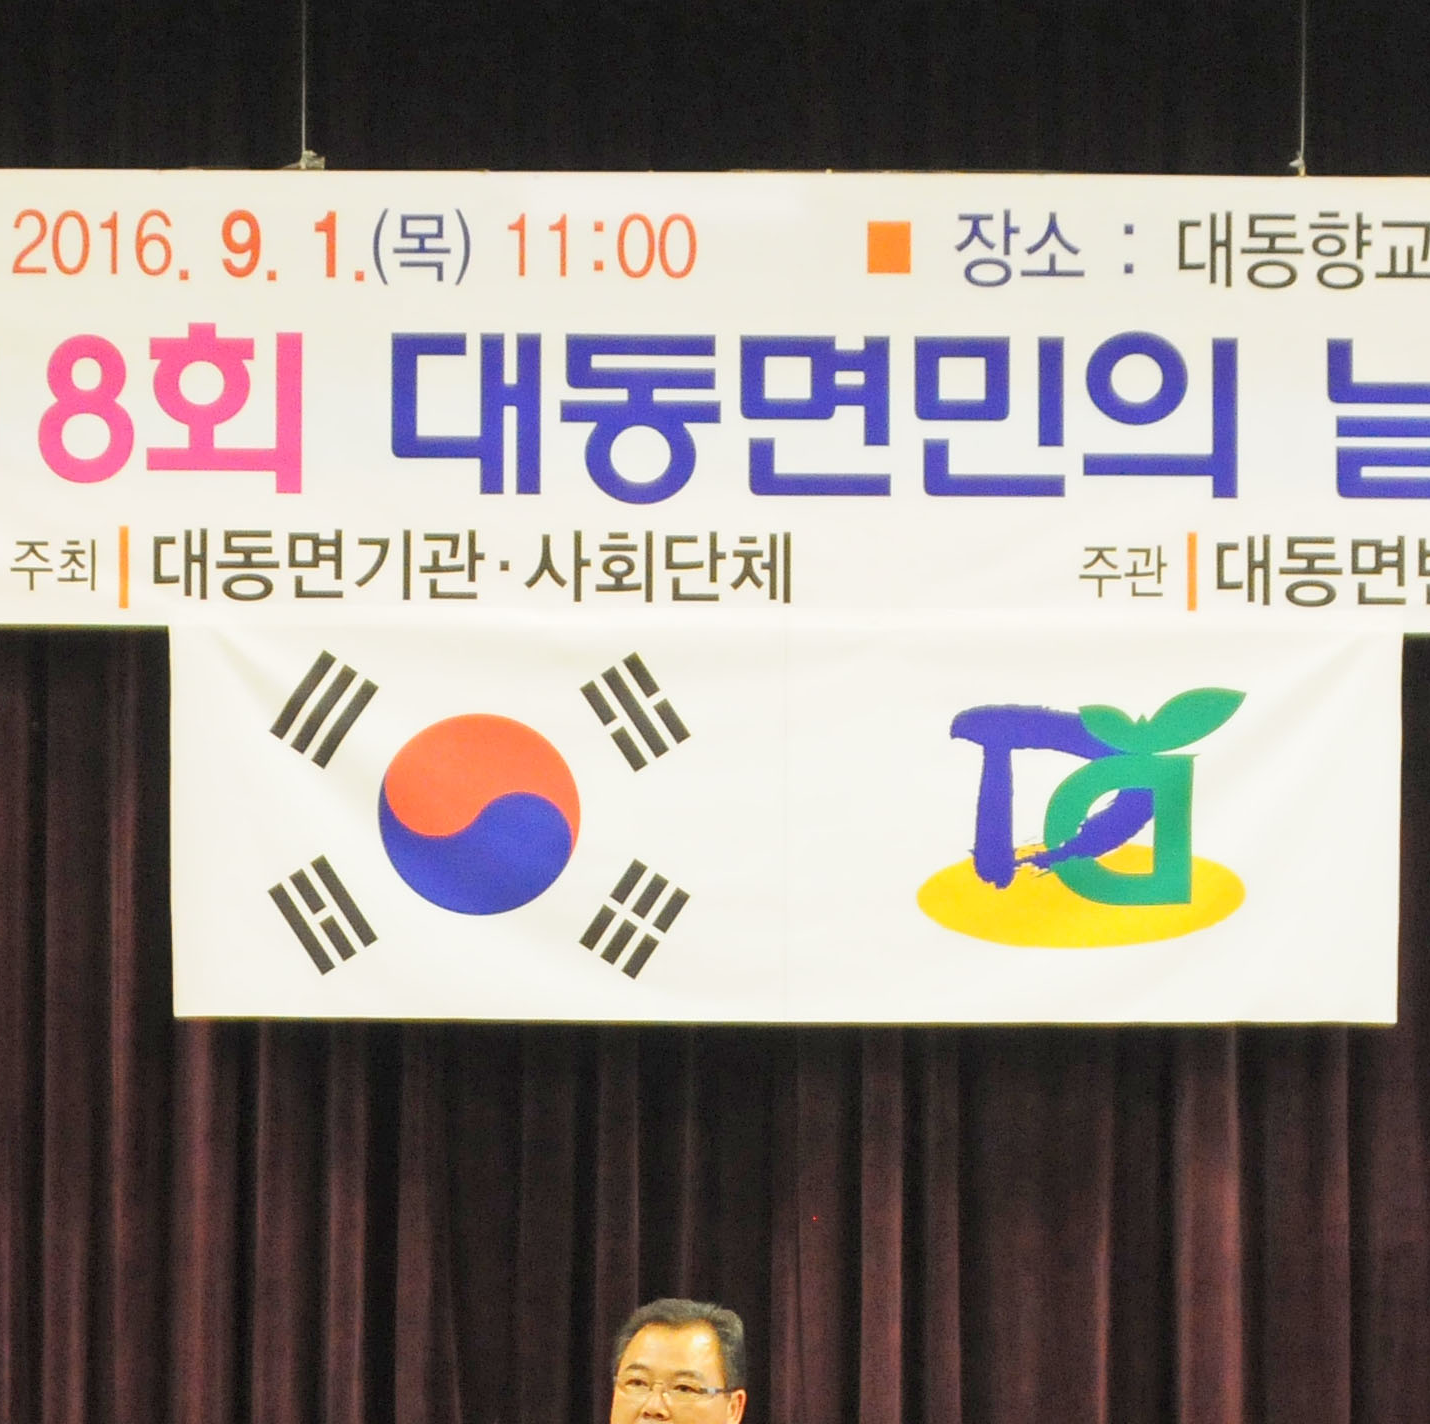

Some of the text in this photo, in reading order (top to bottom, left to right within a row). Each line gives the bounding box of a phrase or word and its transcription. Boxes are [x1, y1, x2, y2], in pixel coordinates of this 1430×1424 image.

[11, 209, 191, 281] 2016.
[220, 209, 278, 282] 9.
[505, 212, 698, 280] 11:00
[954, 209, 1086, 288] 장소
[389, 330, 1240, 506] 대동면민의
[9, 538, 98, 592] 주최
[1078, 544, 1169, 598] 주관
